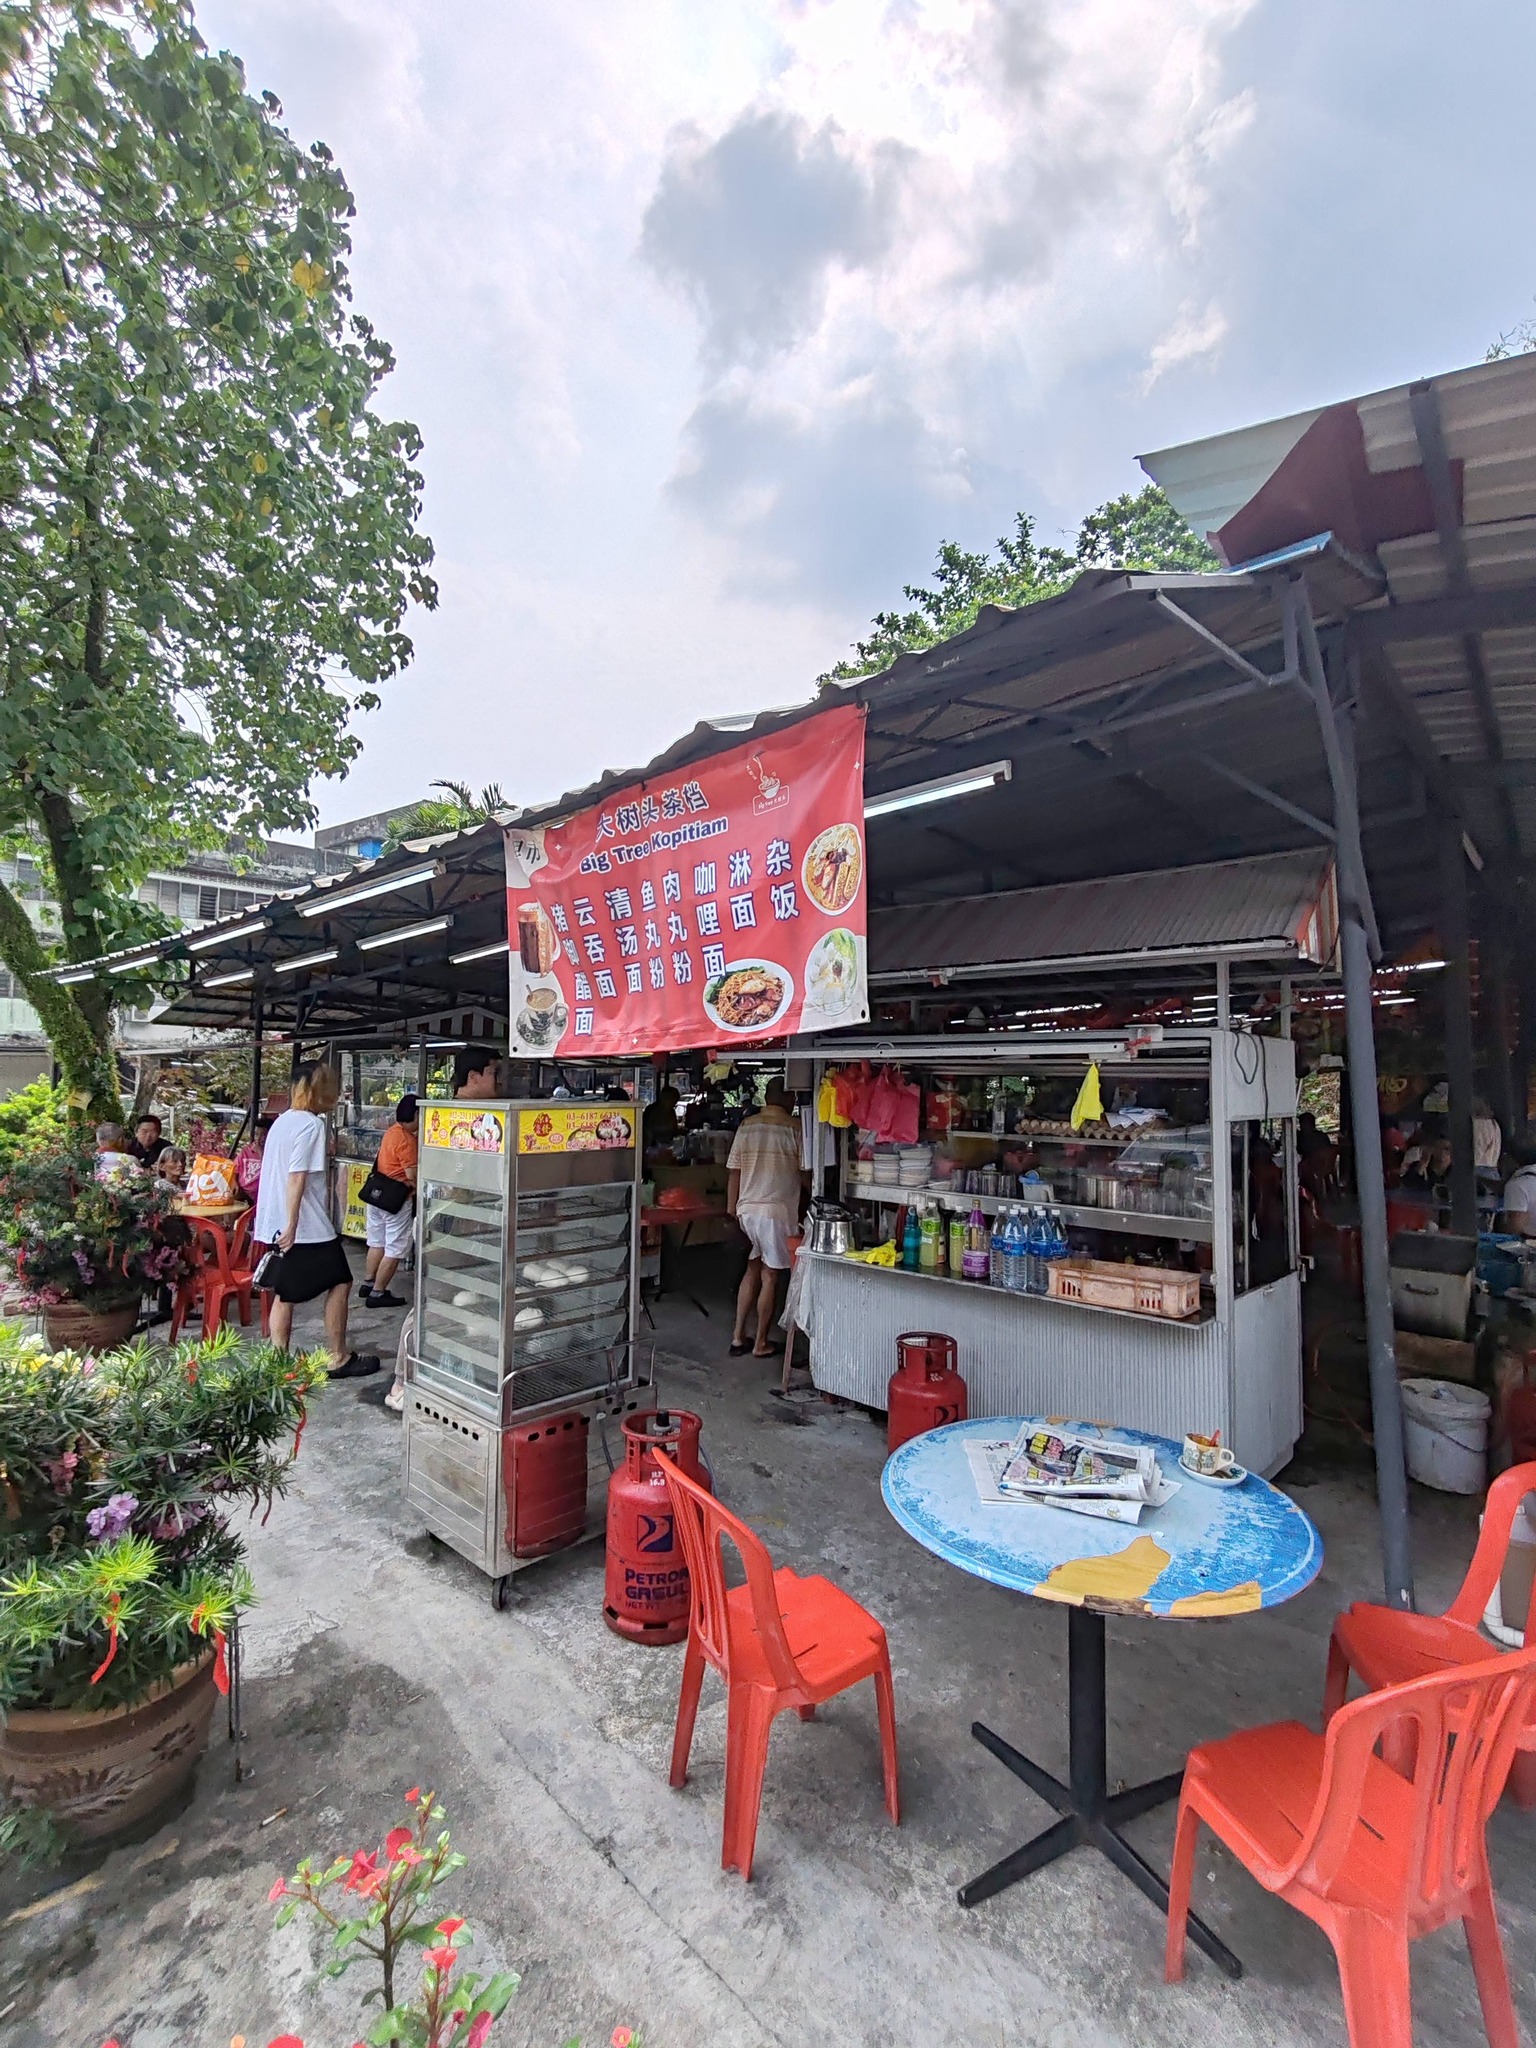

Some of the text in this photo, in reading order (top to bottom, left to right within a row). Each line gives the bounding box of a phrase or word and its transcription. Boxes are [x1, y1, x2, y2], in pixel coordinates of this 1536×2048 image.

[580, 816, 728, 874] Big Tree Kopitiam
[596, 781, 709, 841] 大树头茶档
[662, 870, 693, 985] 肉丸粉
[693, 860, 727, 980] 咖哩面
[728, 849, 757, 932] 淋面
[766, 838, 800, 922] 杂饭
[573, 897, 617, 999] 云吞面
[604, 886, 643, 995] 清汤面
[640, 880, 665, 990] 鱼丸粉
